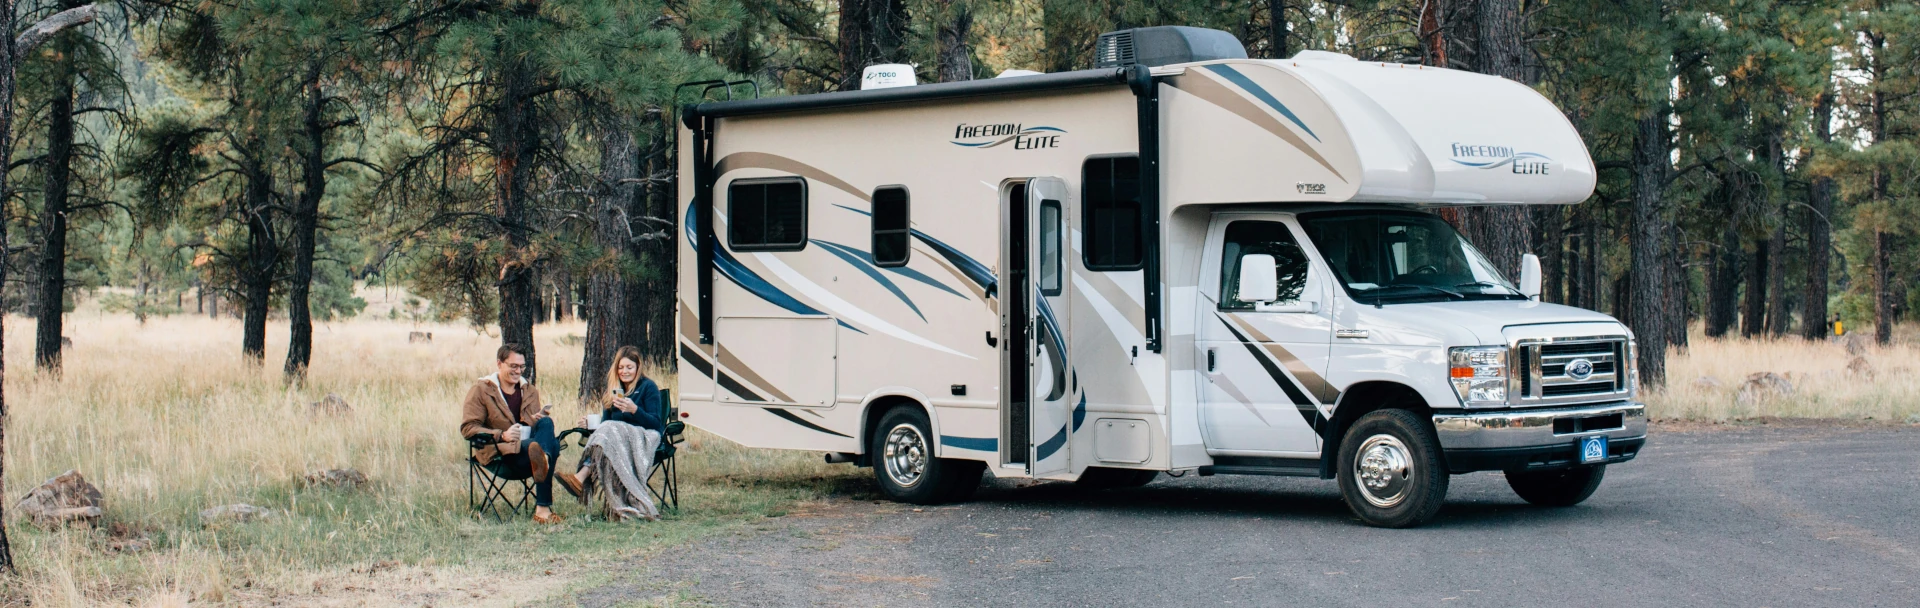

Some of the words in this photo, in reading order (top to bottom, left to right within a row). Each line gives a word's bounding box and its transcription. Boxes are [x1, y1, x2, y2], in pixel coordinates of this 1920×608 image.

[955, 122, 1022, 139] FREEDOM
[1014, 134, 1060, 150] ELITE
[1451, 142, 1514, 158] FREEDOM
[1512, 158, 1549, 175] ELITE
